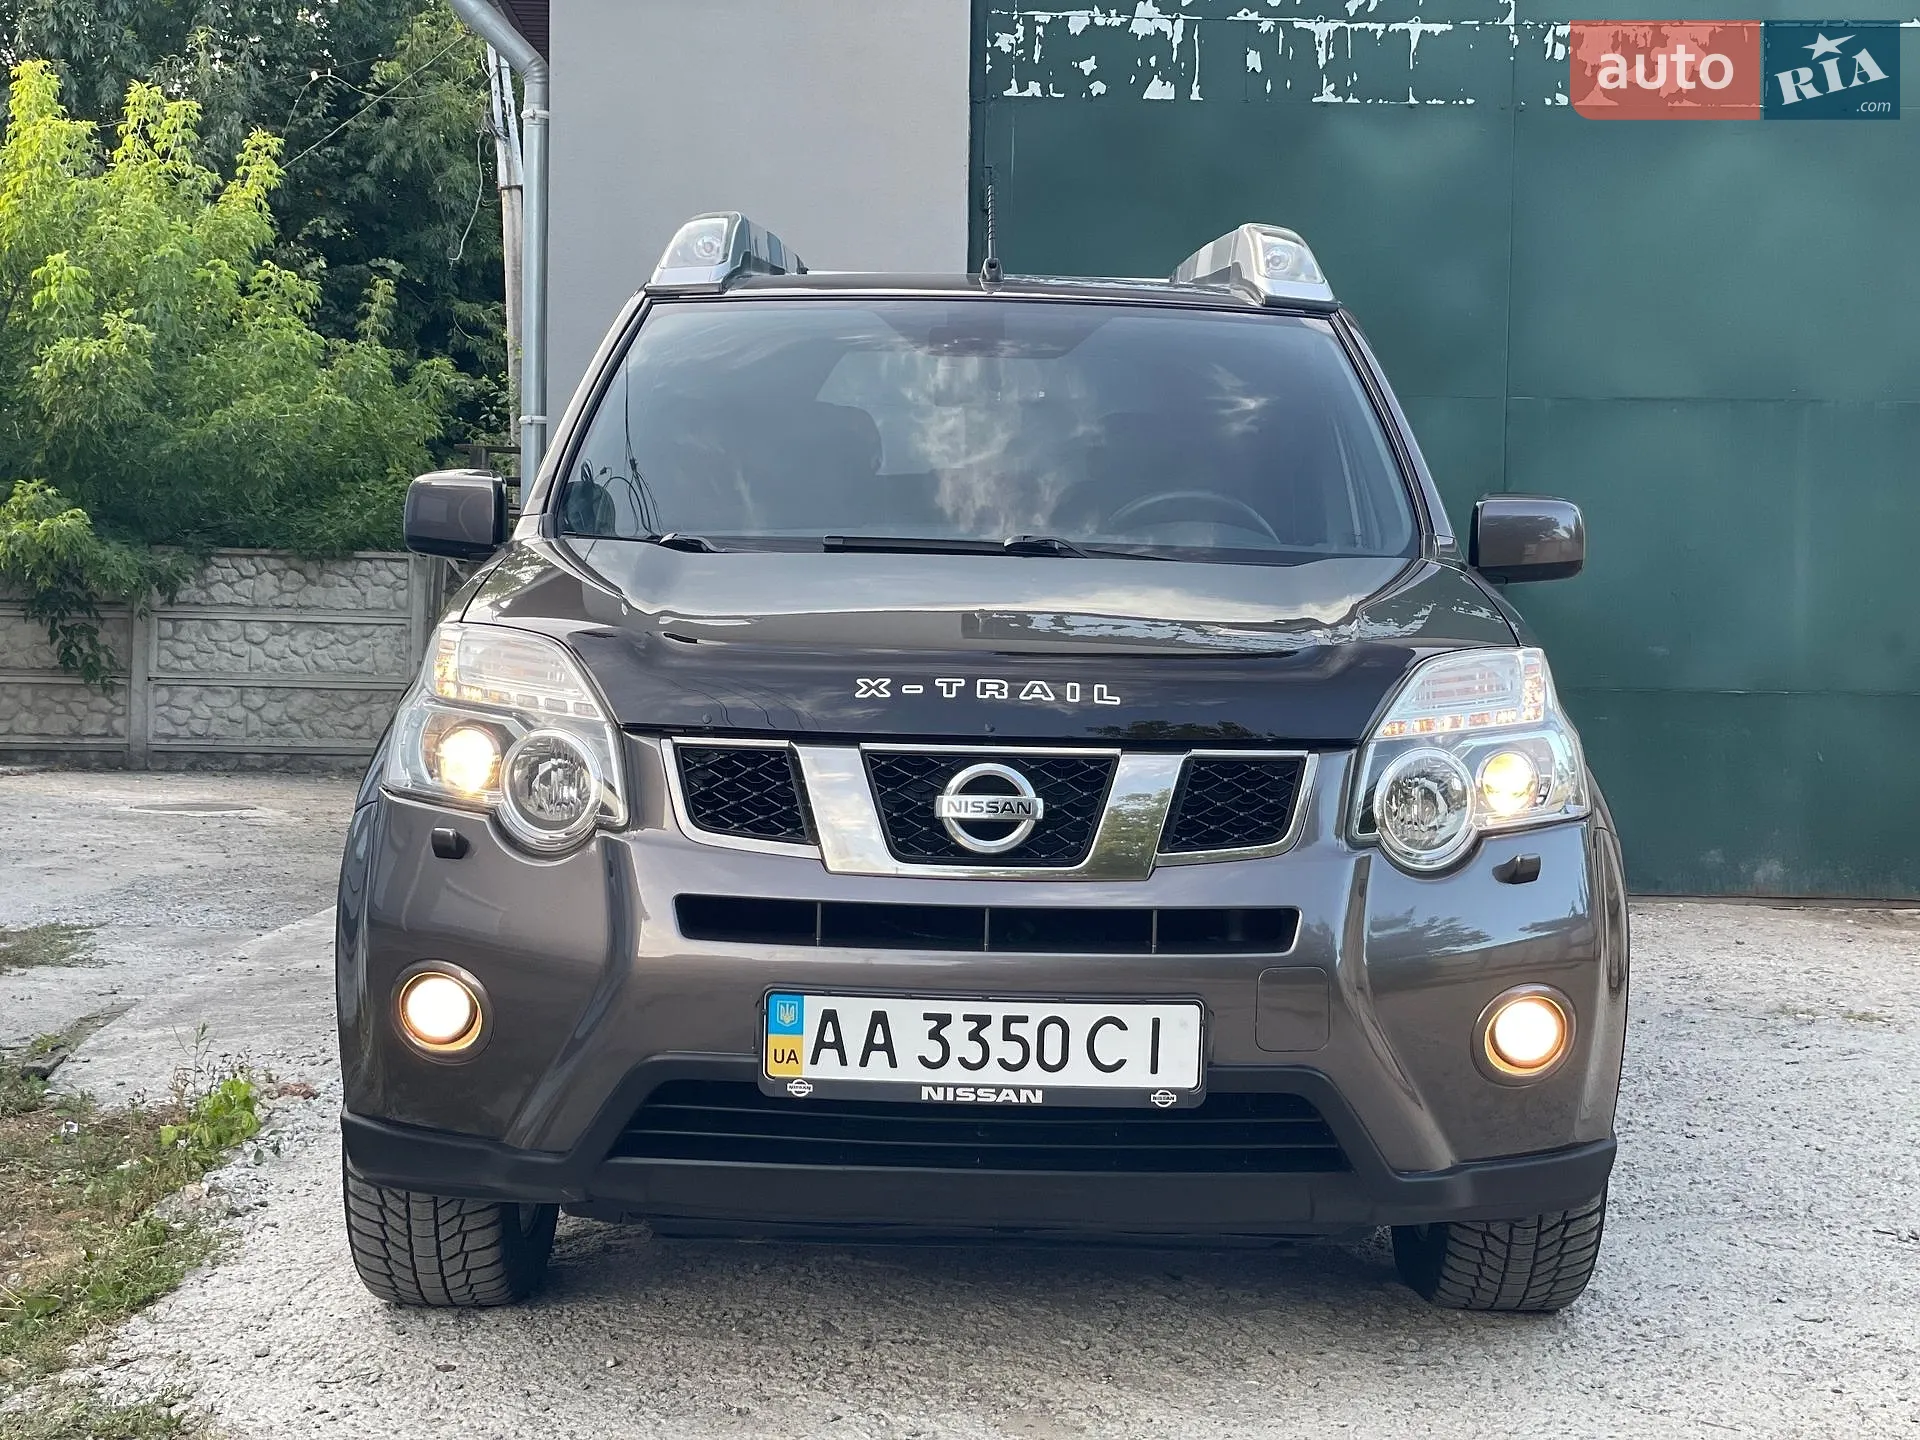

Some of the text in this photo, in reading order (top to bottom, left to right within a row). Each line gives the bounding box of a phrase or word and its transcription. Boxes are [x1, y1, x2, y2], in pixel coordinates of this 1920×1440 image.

[855, 678, 1121, 706] X-TRAIL
[946, 799, 1032, 815] NISSAN
[809, 1008, 1159, 1075] AA 3350 CI
[773, 1048, 800, 1065] UA
[920, 1085, 1043, 1104] NISSAN
